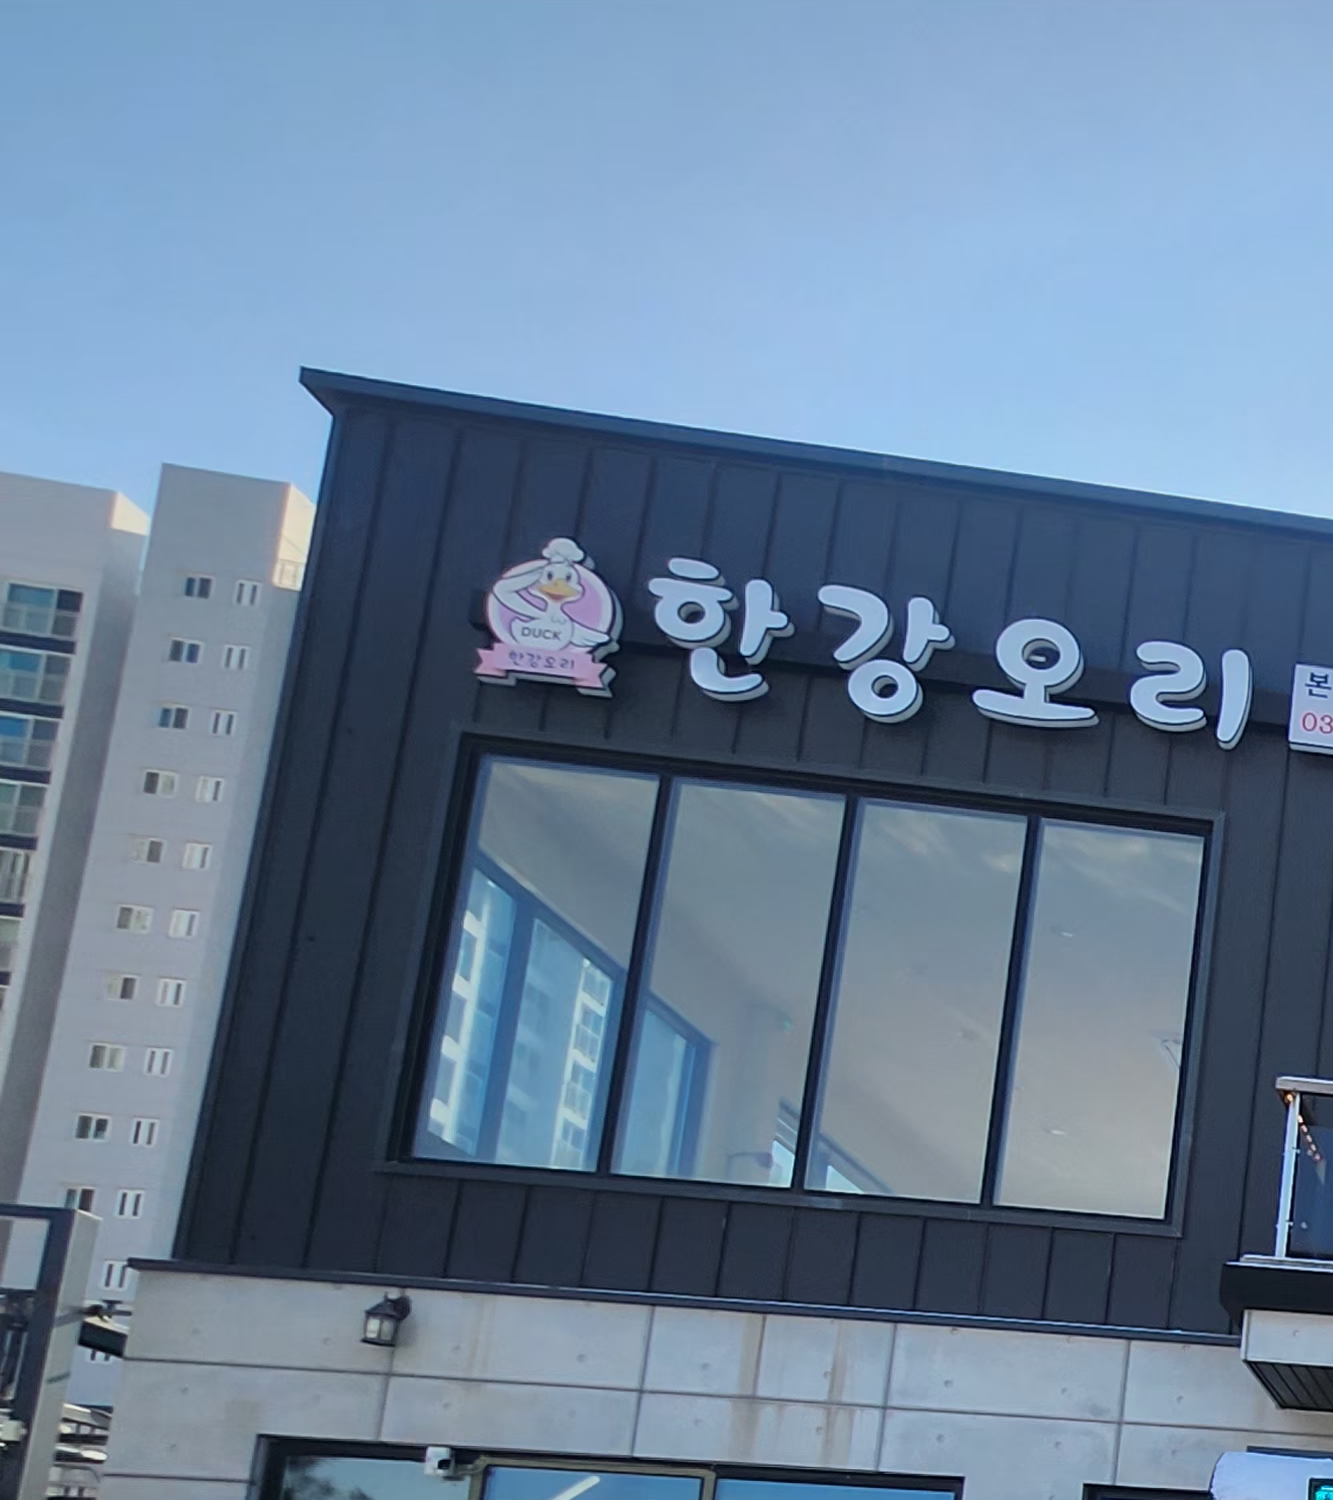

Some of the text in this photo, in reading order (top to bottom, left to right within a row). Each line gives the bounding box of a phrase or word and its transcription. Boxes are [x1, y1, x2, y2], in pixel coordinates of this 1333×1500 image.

[521, 626, 563, 642] DUCK
[508, 650, 576, 669] 한강오리
[649, 557, 1252, 749] 한강오리
